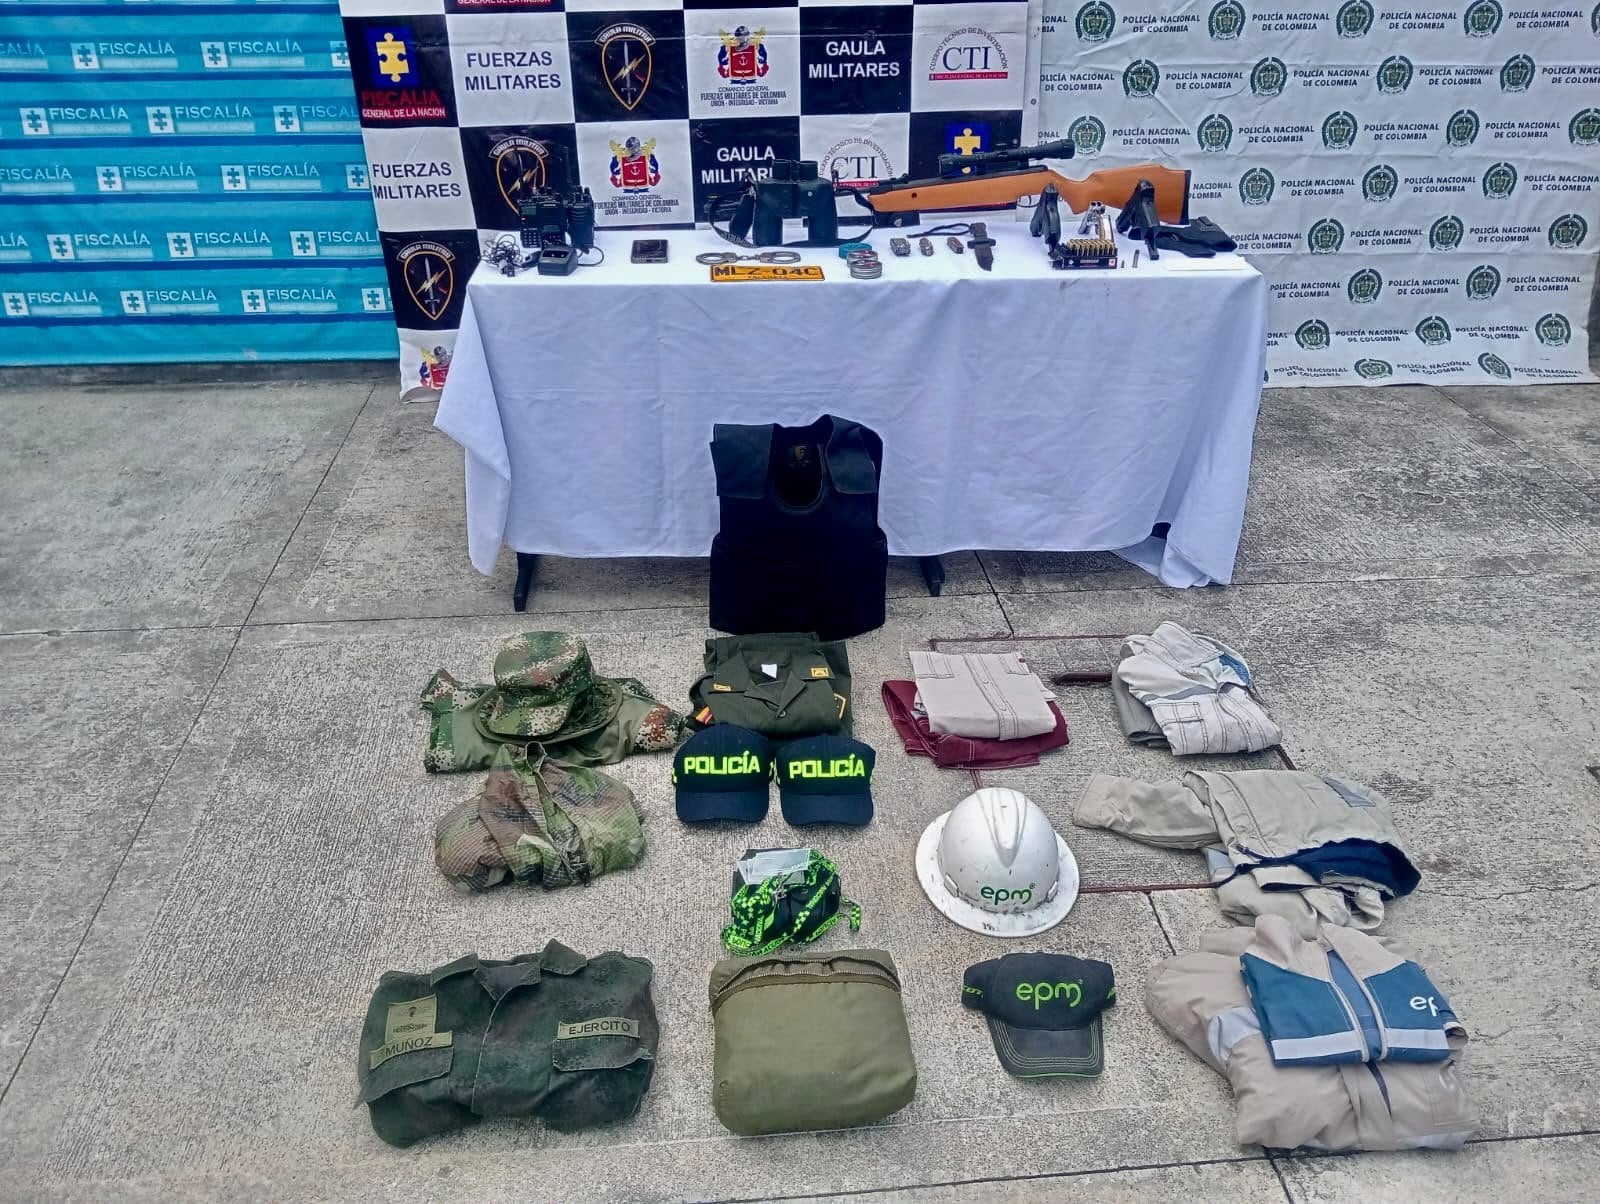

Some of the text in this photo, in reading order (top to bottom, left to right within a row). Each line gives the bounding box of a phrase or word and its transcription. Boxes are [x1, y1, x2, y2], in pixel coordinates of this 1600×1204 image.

[1123, 15, 1200, 23] POLICÍA NACIONAL
[1252, 12, 1282, 21] POLICÍA
[1380, 12, 1412, 20] POLICÍA
[1509, 10, 1538, 19] POLICÍA
[99, 40, 174, 55] FISCALÍA
[228, 39, 301, 54] FISCALÍA
[826, 41, 885, 55] GAULA
[467, 51, 552, 67] FUERZAS
[943, 47, 991, 71] CTI
[809, 62, 899, 78] MILITARES
[1166, 71, 1197, 80] POLICÍA
[1294, 69, 1324, 77] POLICÍA
[1420, 67, 1451, 75] POLICÍA
[465, 74, 561, 90] MILITARES
[1040, 72, 1066, 82] OLICÍA
[49, 106, 129, 121] FISCALÍA
[175, 104, 252, 119] FISCALÍA
[301, 106, 358, 118] FISCAL
[362, 109, 394, 118] GENERAL
[394, 109, 405, 117] DE
[406, 109, 417, 117] LA
[1239, 125, 1270, 134] POLICÍA
[1364, 123, 1395, 131] POLICÍA
[1486, 121, 1515, 129] POLICÍA
[1113, 128, 1145, 136] POLICÍA
[717, 146, 775, 161] GAULA
[122, 164, 195, 178] FISCALÍA
[248, 163, 319, 176] FISCALÍA
[373, 162, 451, 178] FUERZAS
[831, 157, 878, 179] CTI
[1405, 176, 1433, 184] POLICÍA
[373, 183, 461, 199] MILITARES
[194, 229, 270, 243] FISCALÍA
[1351, 229, 1380, 237] POLICÍA
[1470, 226, 1499, 234] POLICÍA
[75, 230, 150, 246] FISCALÍA
[318, 231, 375, 243] FISCAL
[1270, 282, 1298, 291] POLICÍA
[28, 290, 98, 304] FISCALÍA
[146, 288, 216, 301] FISCALÍA
[267, 287, 335, 300] FISCALÍA
[684, 750, 760, 774] POLICÍA
[789, 754, 865, 779] POLICÍA
[981, 886, 1032, 905] epm
[1016, 982, 1081, 1010] epm
[569, 1020, 631, 1035] EJERCITO
